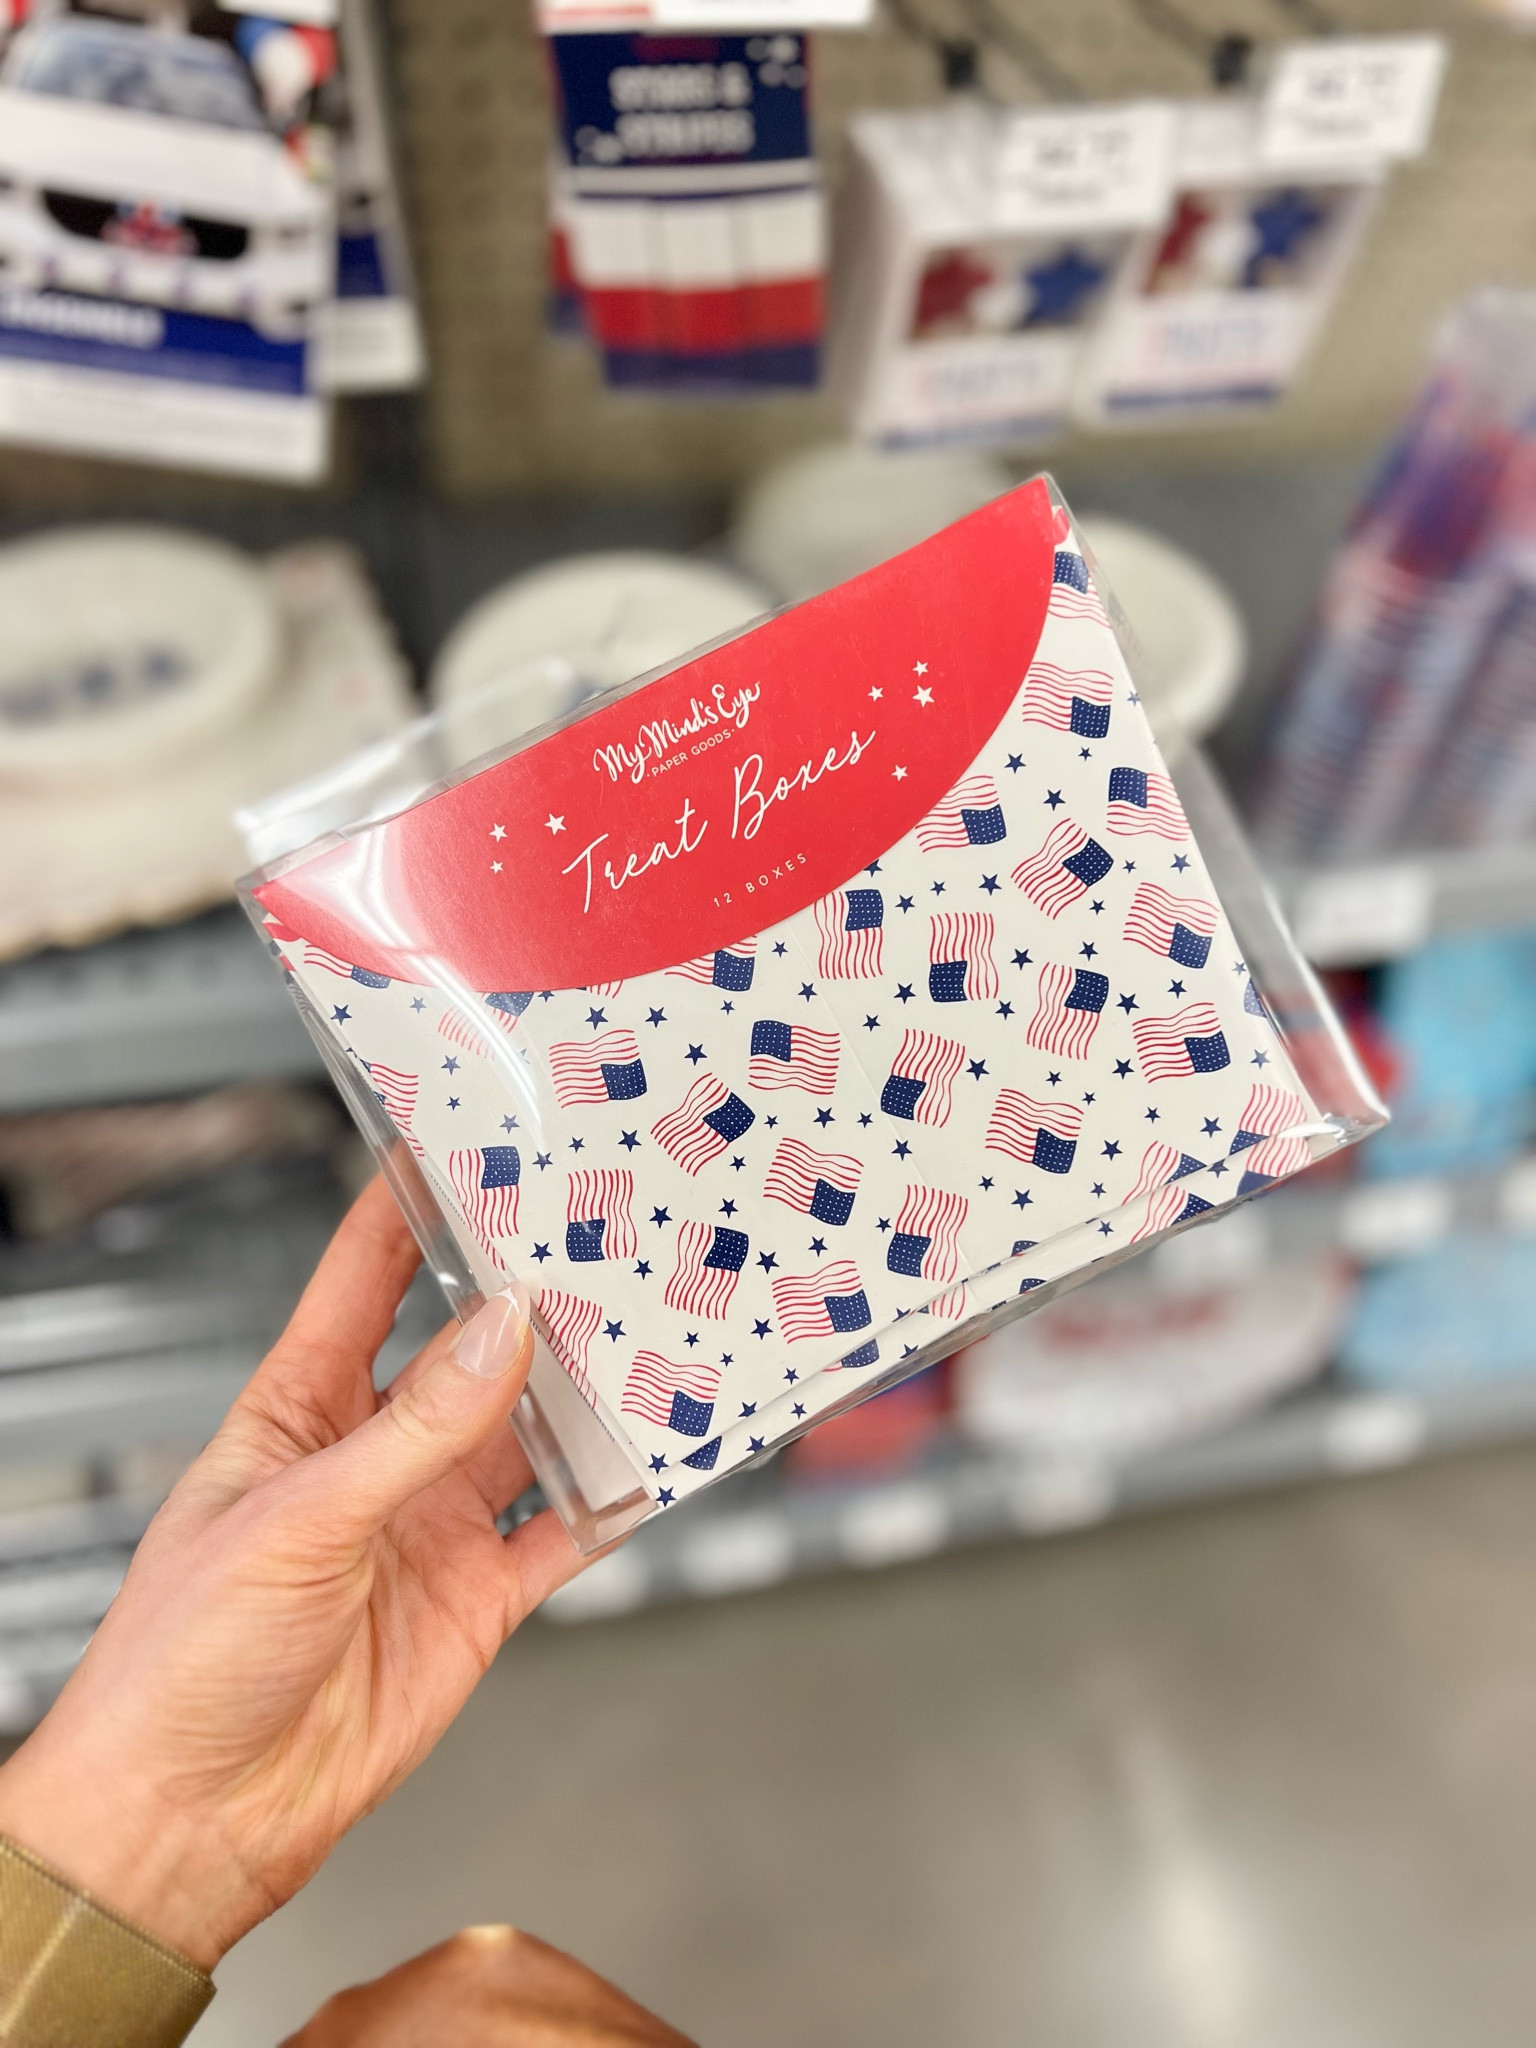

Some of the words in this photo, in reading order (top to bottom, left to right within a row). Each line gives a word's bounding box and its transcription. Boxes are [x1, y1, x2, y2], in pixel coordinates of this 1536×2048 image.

[593, 743, 651, 784] My
[638, 698, 719, 758] Mind's
[711, 683, 761, 729] Eye
[651, 752, 688, 777] PAPER
[690, 728, 731, 756] GOODS
[562, 798, 708, 913] Treat
[731, 730, 876, 840] Boxes
[713, 892, 733, 908] 12
[745, 852, 807, 894] BOXES
